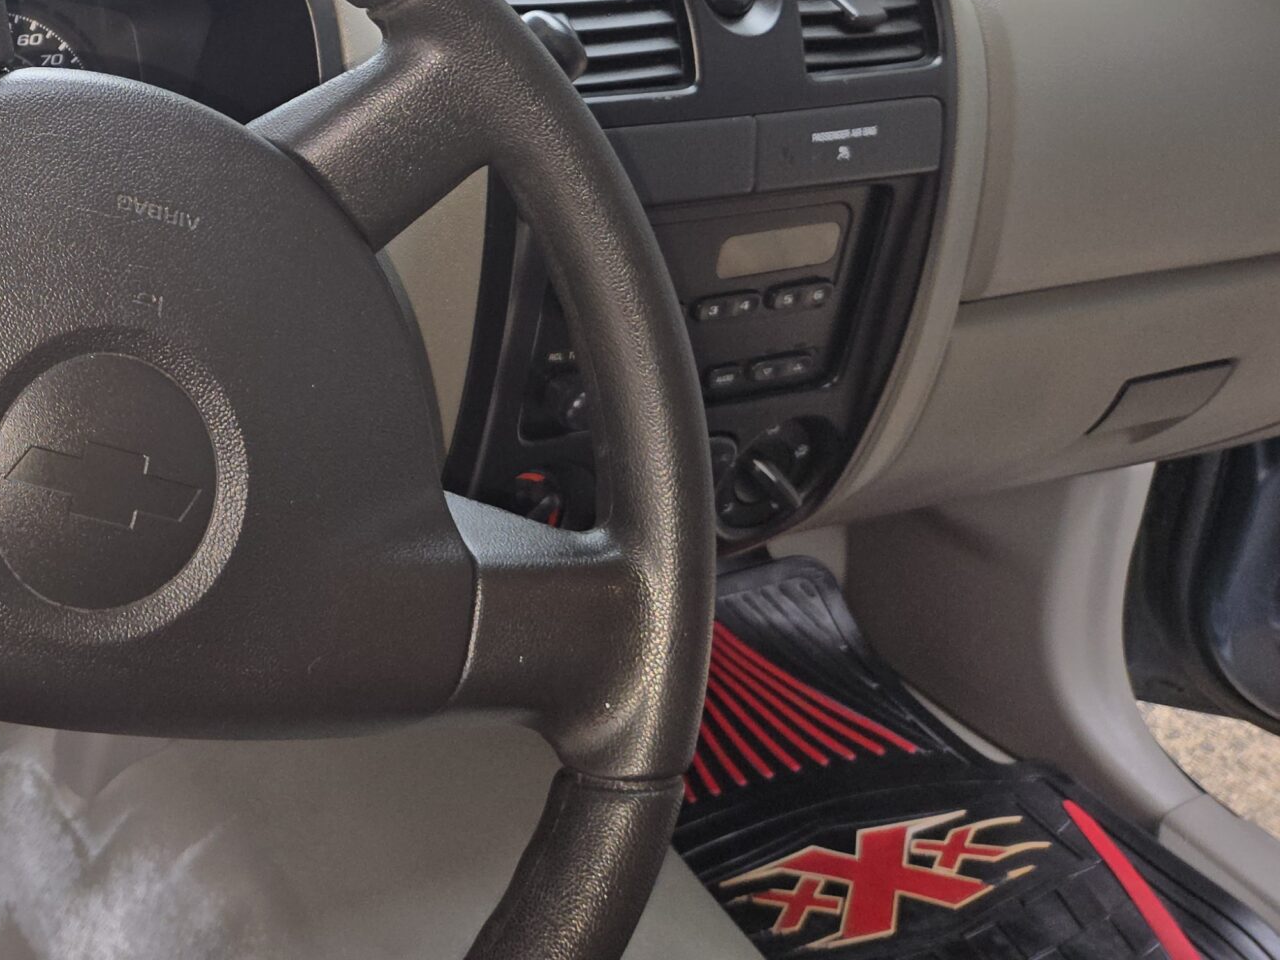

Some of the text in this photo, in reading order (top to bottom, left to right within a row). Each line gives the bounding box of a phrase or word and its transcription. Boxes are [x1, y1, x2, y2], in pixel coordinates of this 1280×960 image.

[16, 33, 43, 47] 60
[40, 53, 64, 66] 70
[117, 194, 200, 230] AIRBAG
[739, 300, 750, 311] 4
[783, 294, 794, 305] 5
[813, 290, 825, 300] 6
